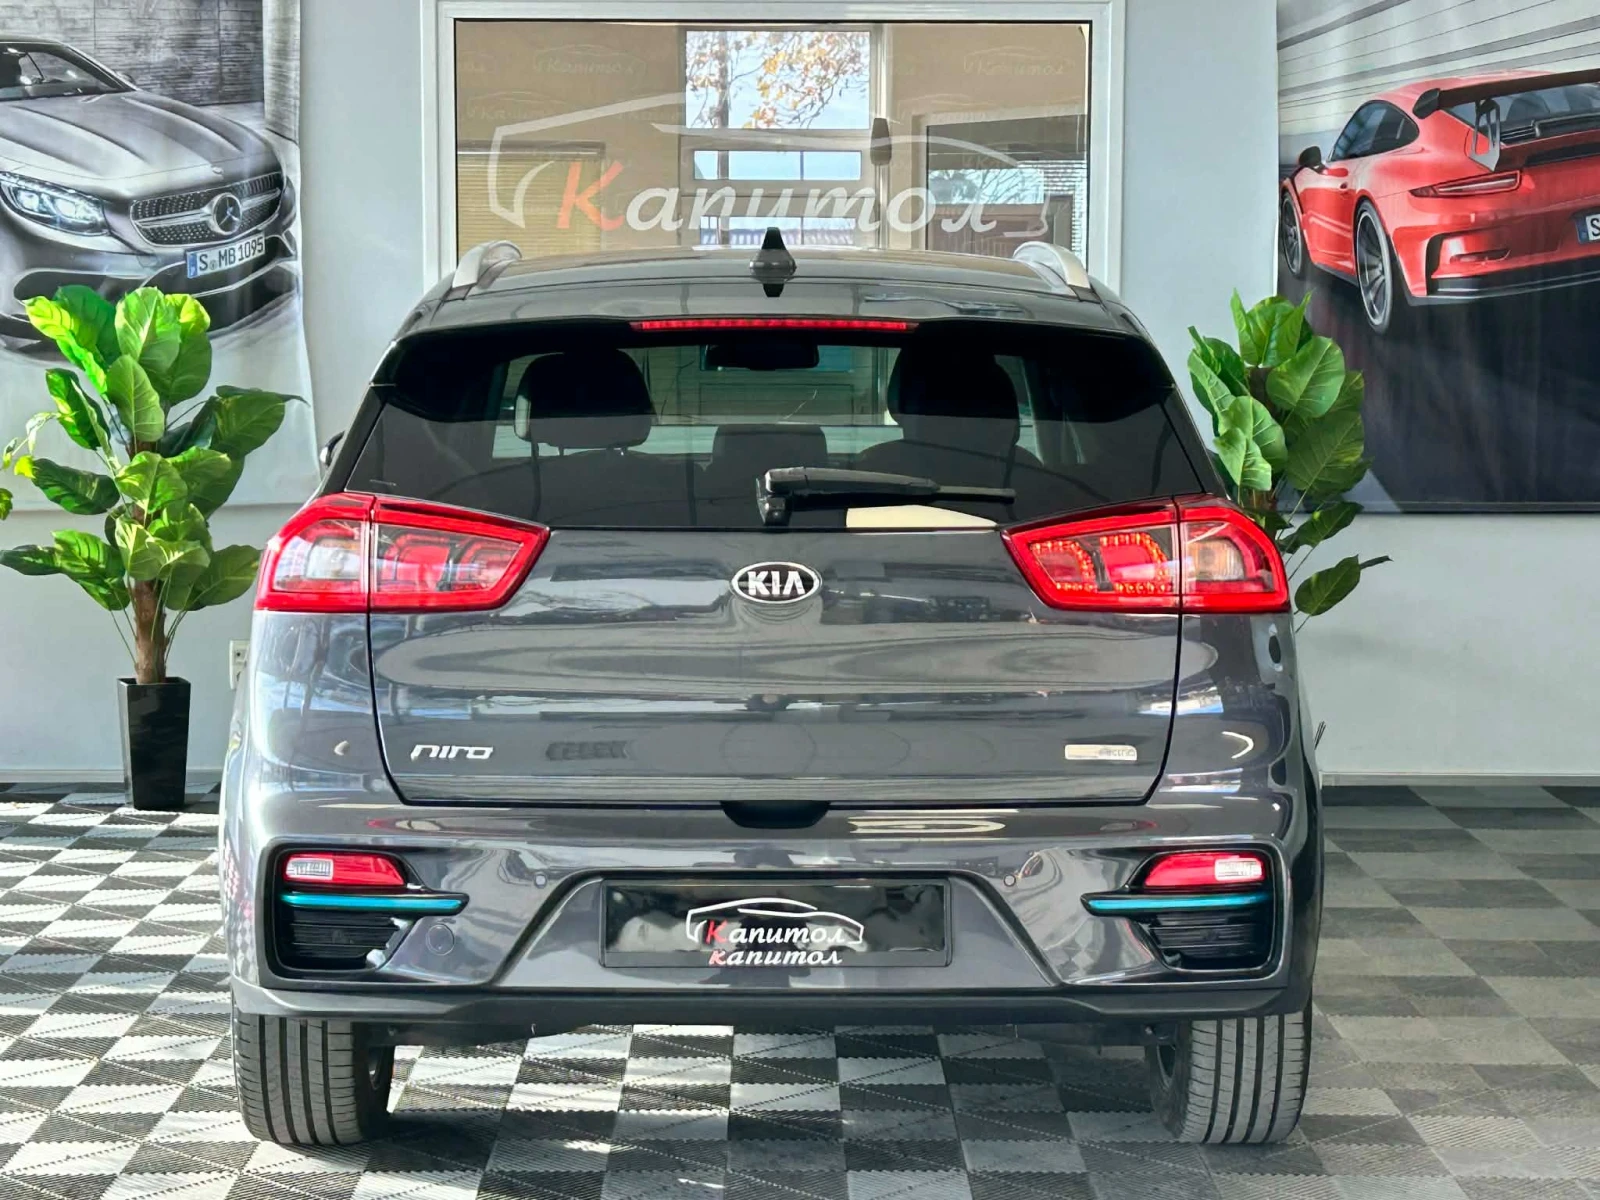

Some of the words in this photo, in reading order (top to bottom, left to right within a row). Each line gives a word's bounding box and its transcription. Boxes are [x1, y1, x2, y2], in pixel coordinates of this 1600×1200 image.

[556, 161, 998, 233] Капитол
[747, 570, 806, 596] KIA
[408, 744, 494, 761] niro
[704, 918, 846, 945] Капитол
